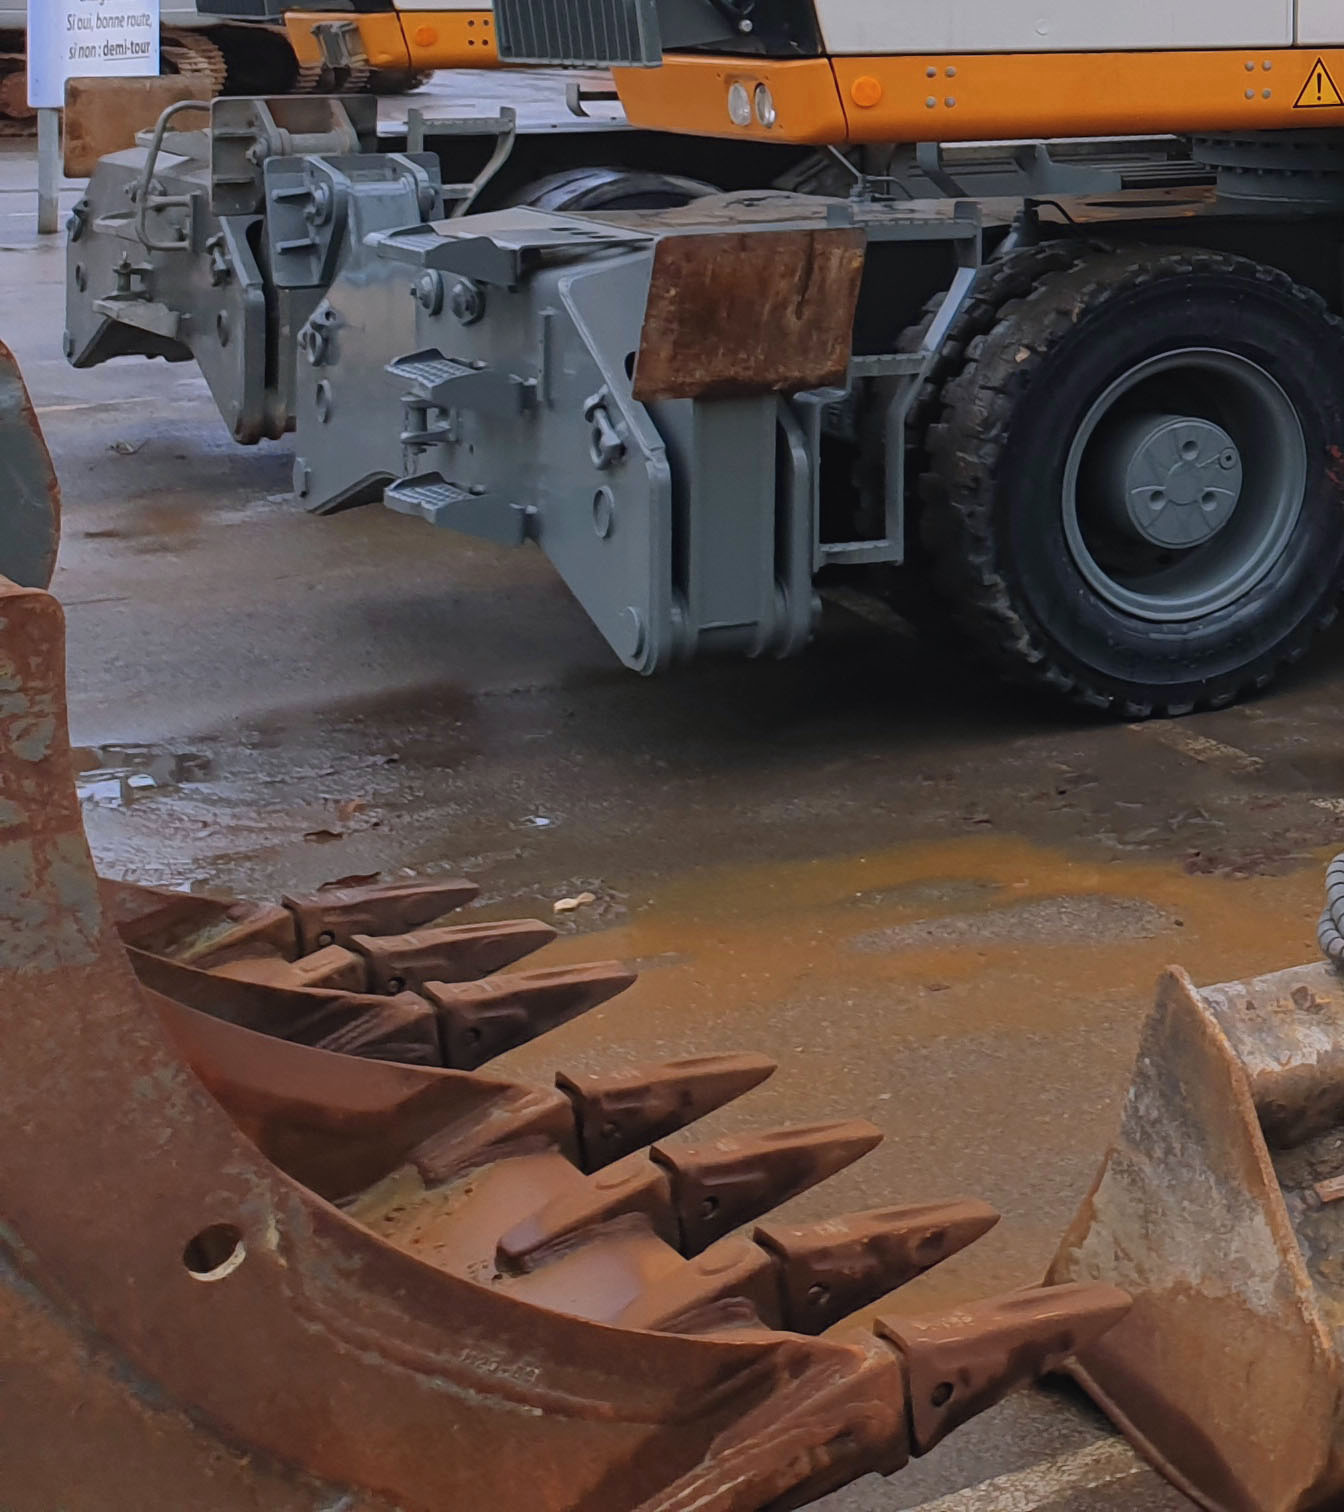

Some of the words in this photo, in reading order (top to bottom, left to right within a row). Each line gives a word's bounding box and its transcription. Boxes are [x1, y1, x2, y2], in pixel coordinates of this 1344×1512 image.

[66, 13, 76, 31] Si
[96, 11, 125, 29] bonne
[68, 42, 77, 60] si
[78, 45, 97, 59] non
[103, 38, 151, 58] demi-tour
